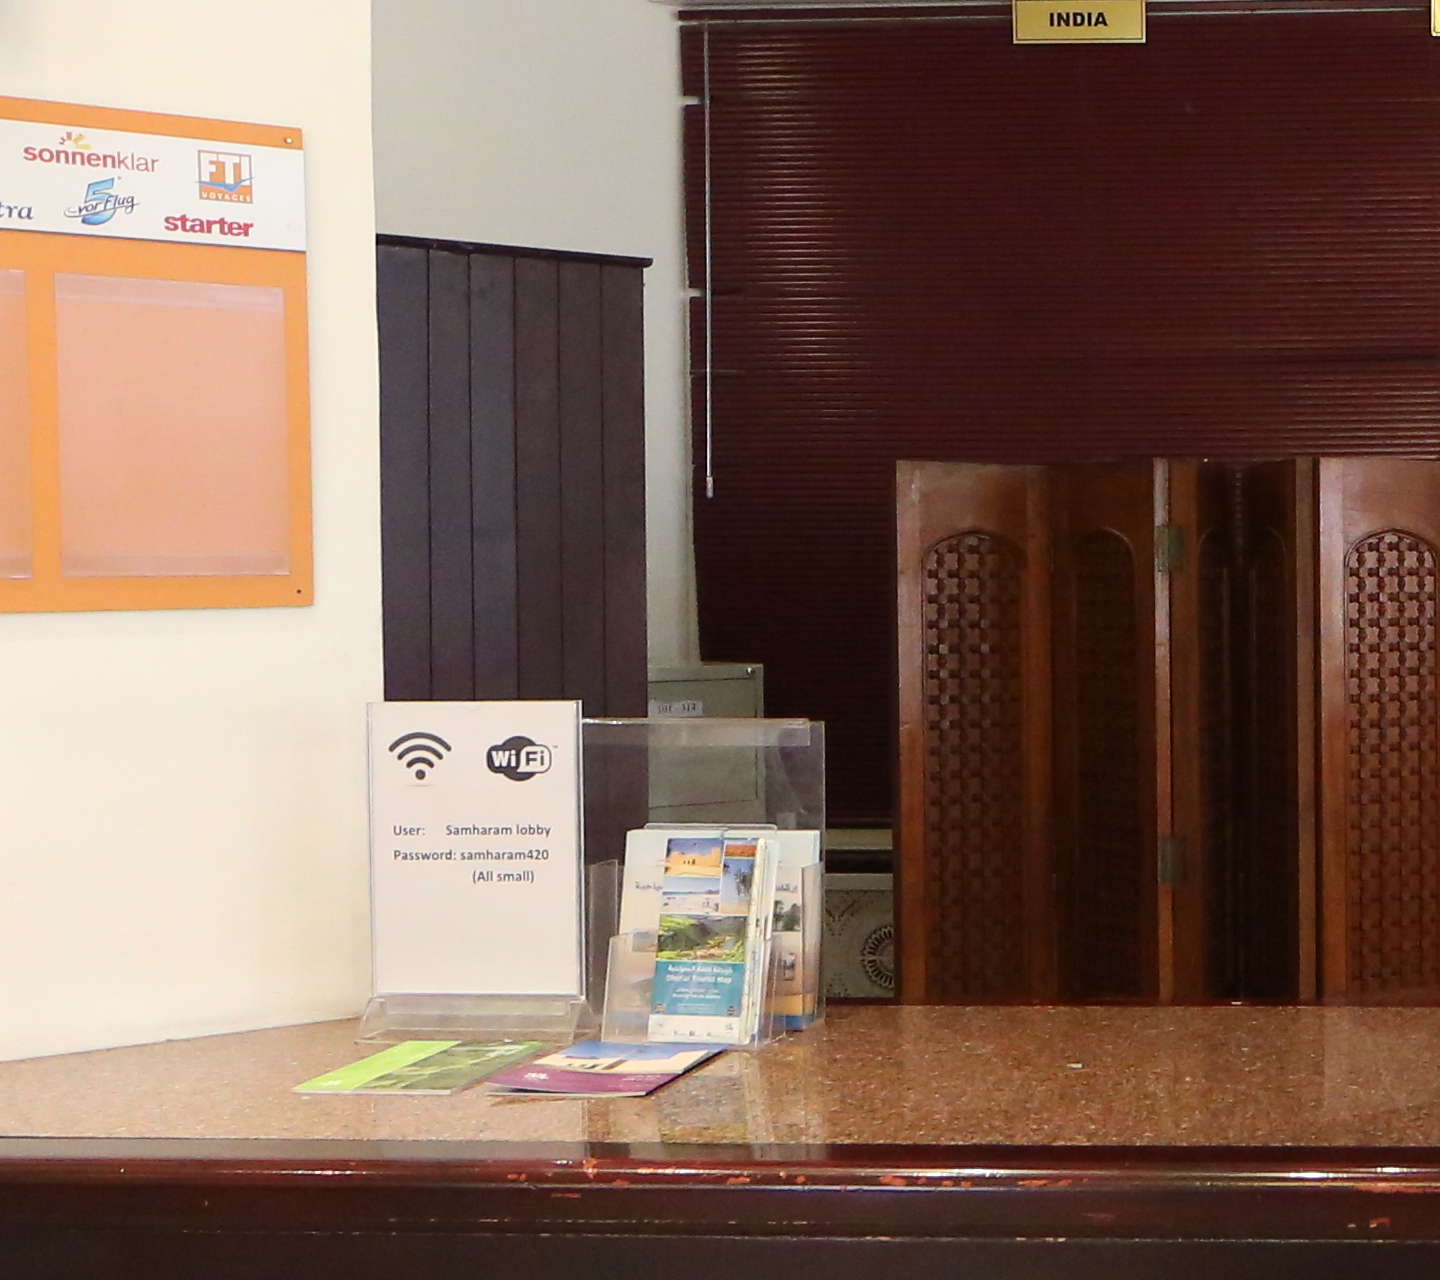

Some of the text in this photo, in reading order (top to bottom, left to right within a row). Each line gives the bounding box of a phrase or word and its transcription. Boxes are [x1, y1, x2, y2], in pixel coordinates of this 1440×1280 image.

[1049, 12, 1108, 27] INDIA
[23, 146, 159, 173] sonnenklar
[200, 152, 251, 186] FTI
[77, 193, 135, 216] vor Flug
[81, 177, 116, 225] 5
[202, 190, 252, 203] VOYAGES
[163, 214, 254, 238] starter
[392, 822, 552, 840] User: Samharam lobby
[392, 848, 550, 862] Password: samharam420
[471, 869, 535, 885] (All small)
